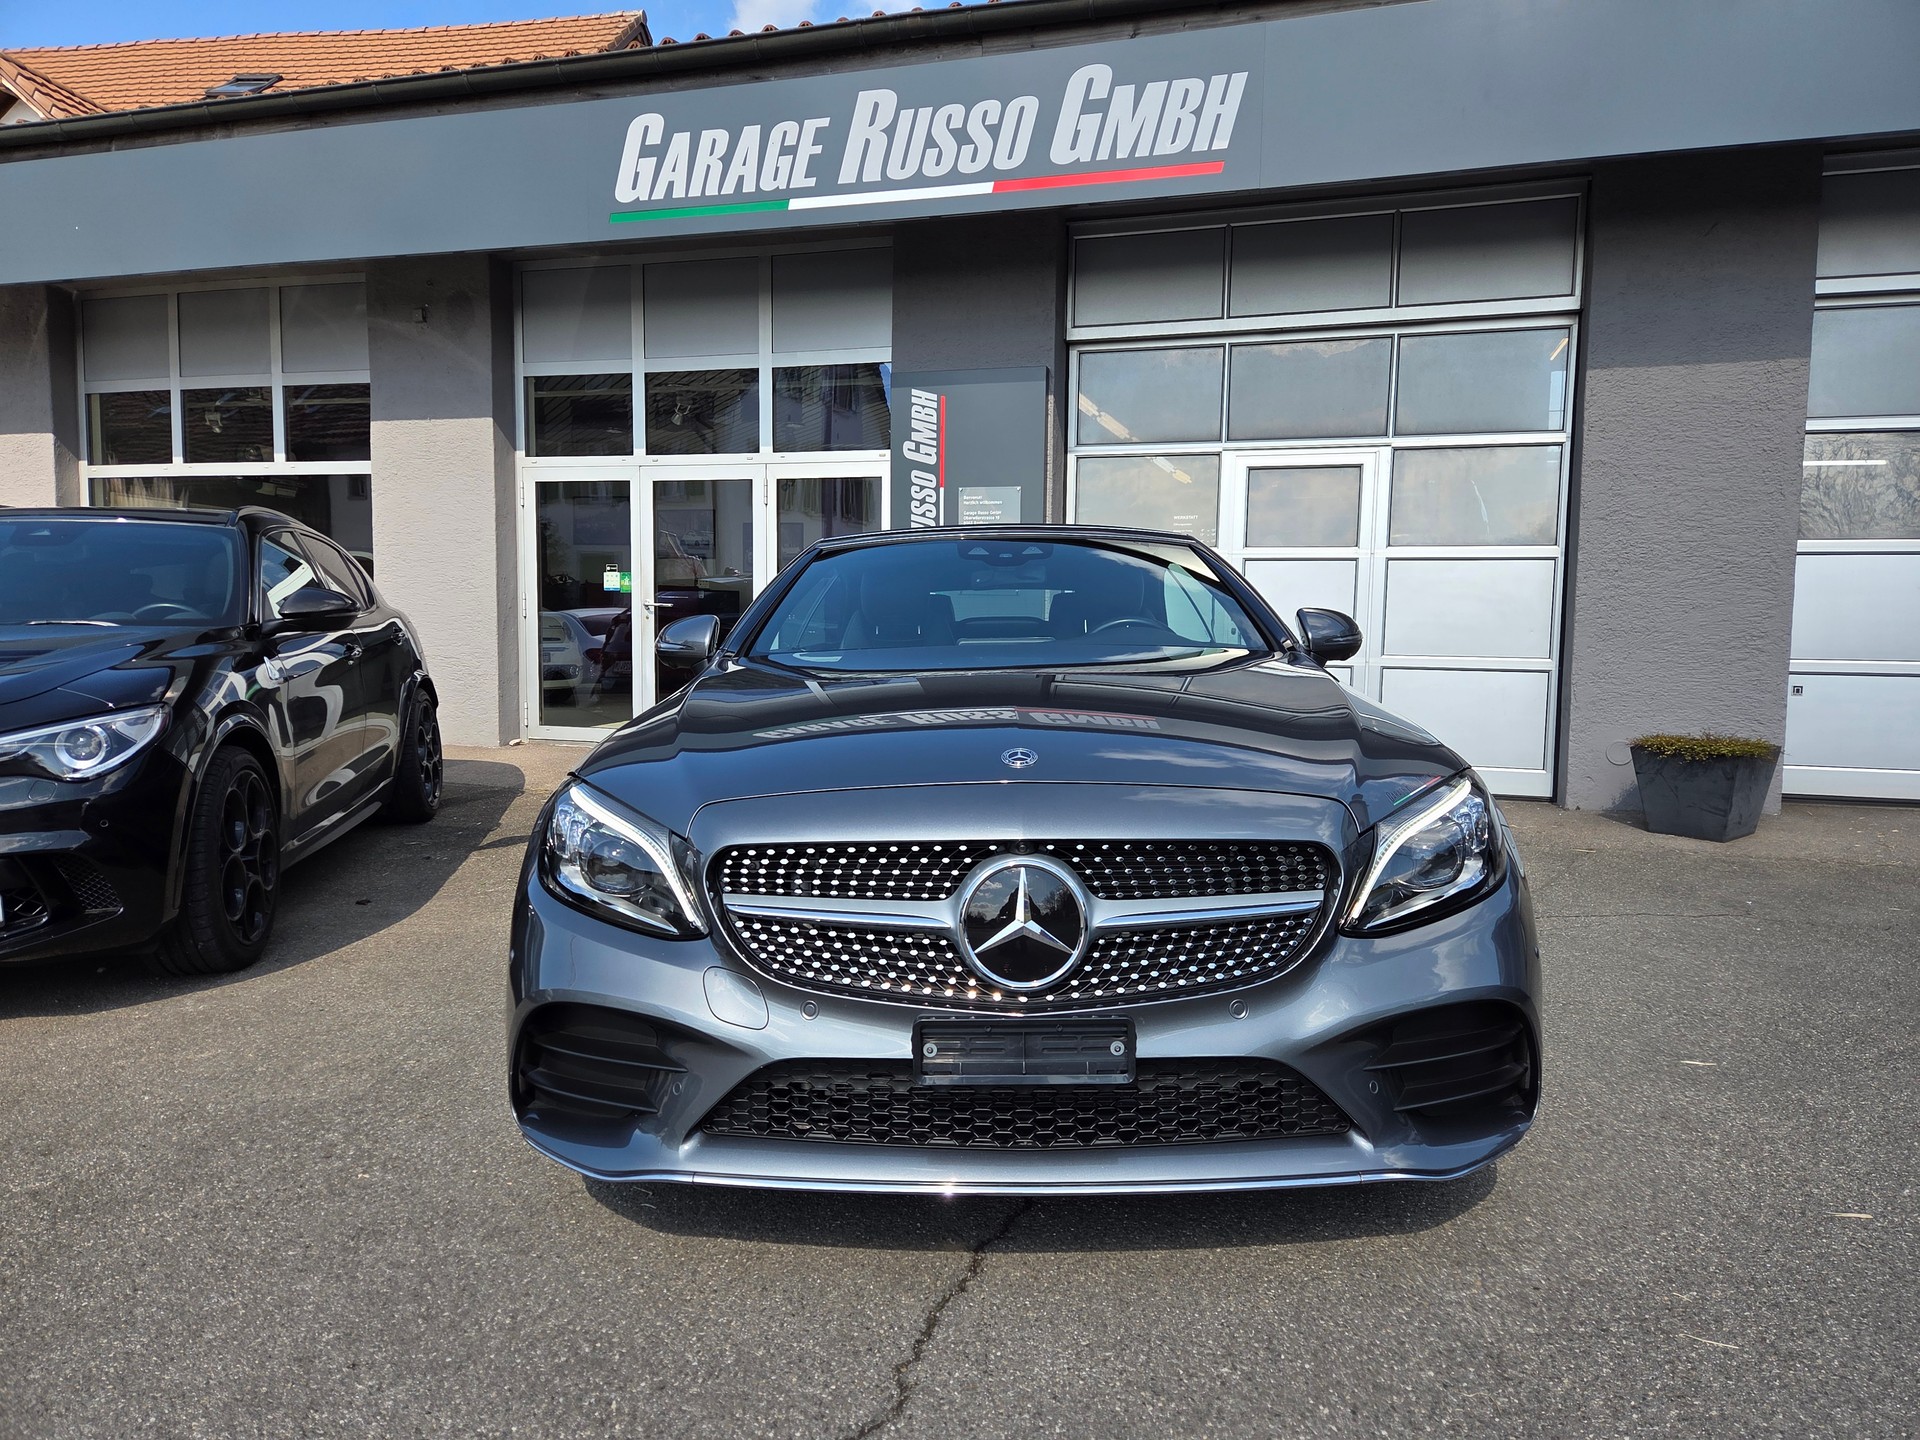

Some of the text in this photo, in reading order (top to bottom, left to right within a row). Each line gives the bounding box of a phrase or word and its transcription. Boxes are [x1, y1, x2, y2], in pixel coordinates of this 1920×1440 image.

[614, 63, 1249, 204] GARAGE RUSSO GMBH
[902, 388, 938, 529] USSO GMBH
